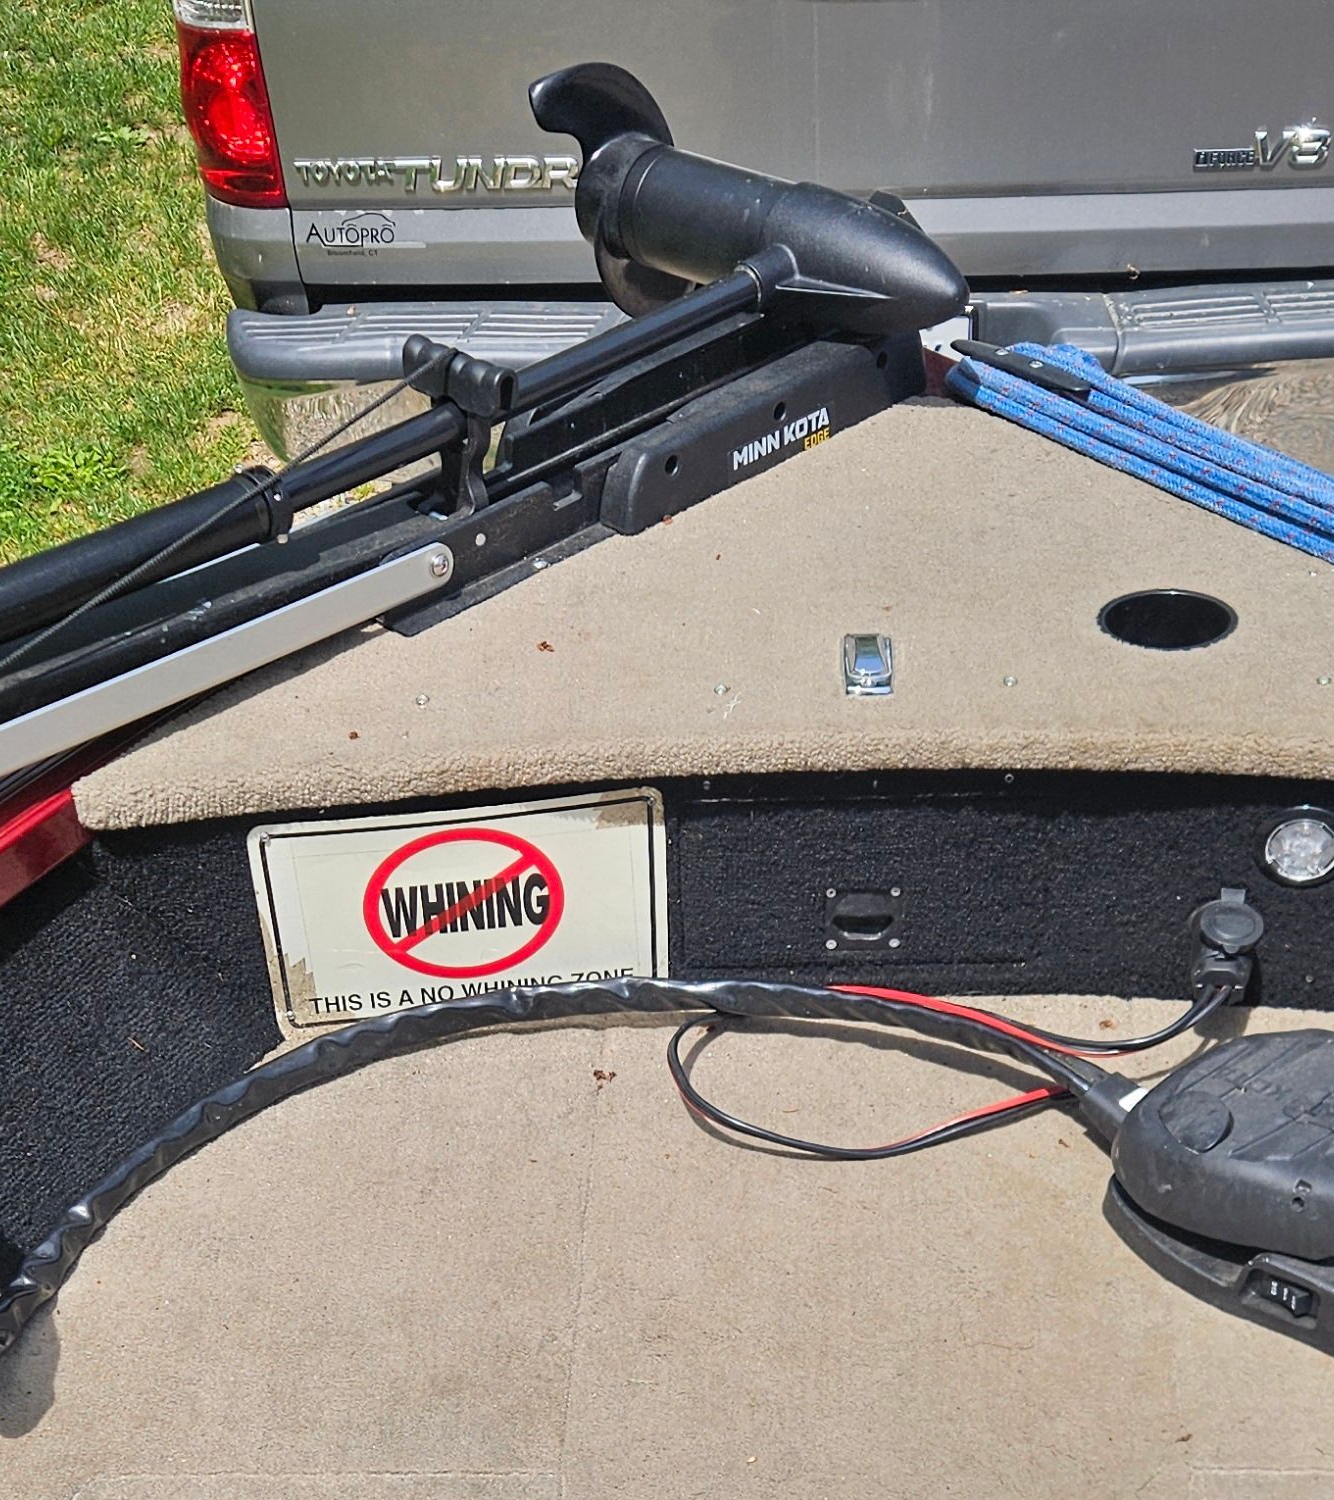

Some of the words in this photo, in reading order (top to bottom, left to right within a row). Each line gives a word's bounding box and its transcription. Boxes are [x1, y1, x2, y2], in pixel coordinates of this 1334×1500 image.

[1254, 128, 1331, 170] V8
[293, 158, 394, 187] TOYOTA
[394, 156, 579, 193] TUNDR
[733, 430, 780, 471] MINN
[784, 407, 830, 446] KOTA
[804, 427, 830, 450] EDGE
[381, 873, 550, 938] WHINING
[308, 993, 363, 1014] THIS
[369, 991, 391, 1009] IS
[398, 989, 415, 1006] A
[420, 985, 454, 1005] NO
